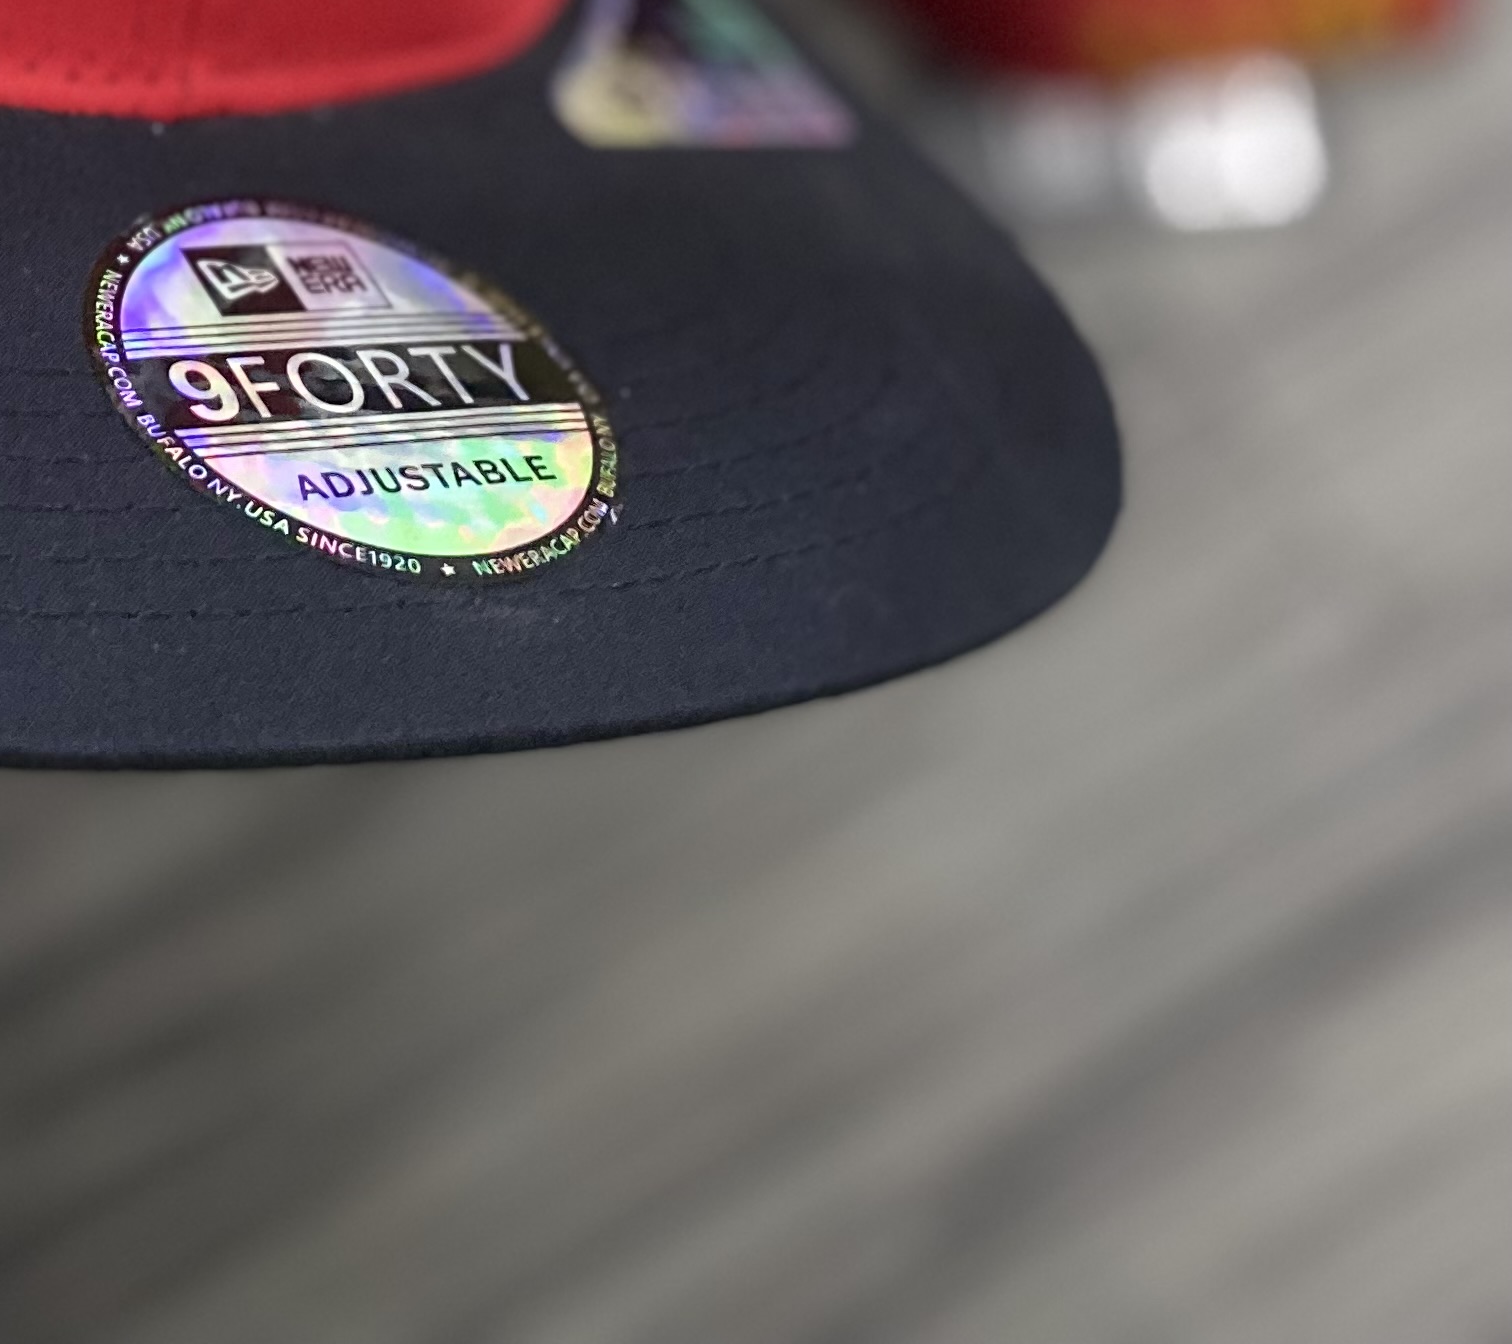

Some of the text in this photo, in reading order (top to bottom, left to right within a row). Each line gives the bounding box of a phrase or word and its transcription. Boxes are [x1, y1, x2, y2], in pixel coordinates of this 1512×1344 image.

[287, 255, 353, 275] NEW
[301, 272, 368, 295] ERA
[168, 343, 530, 422] 9FORTY
[298, 455, 557, 501] ADJUSTABLE
